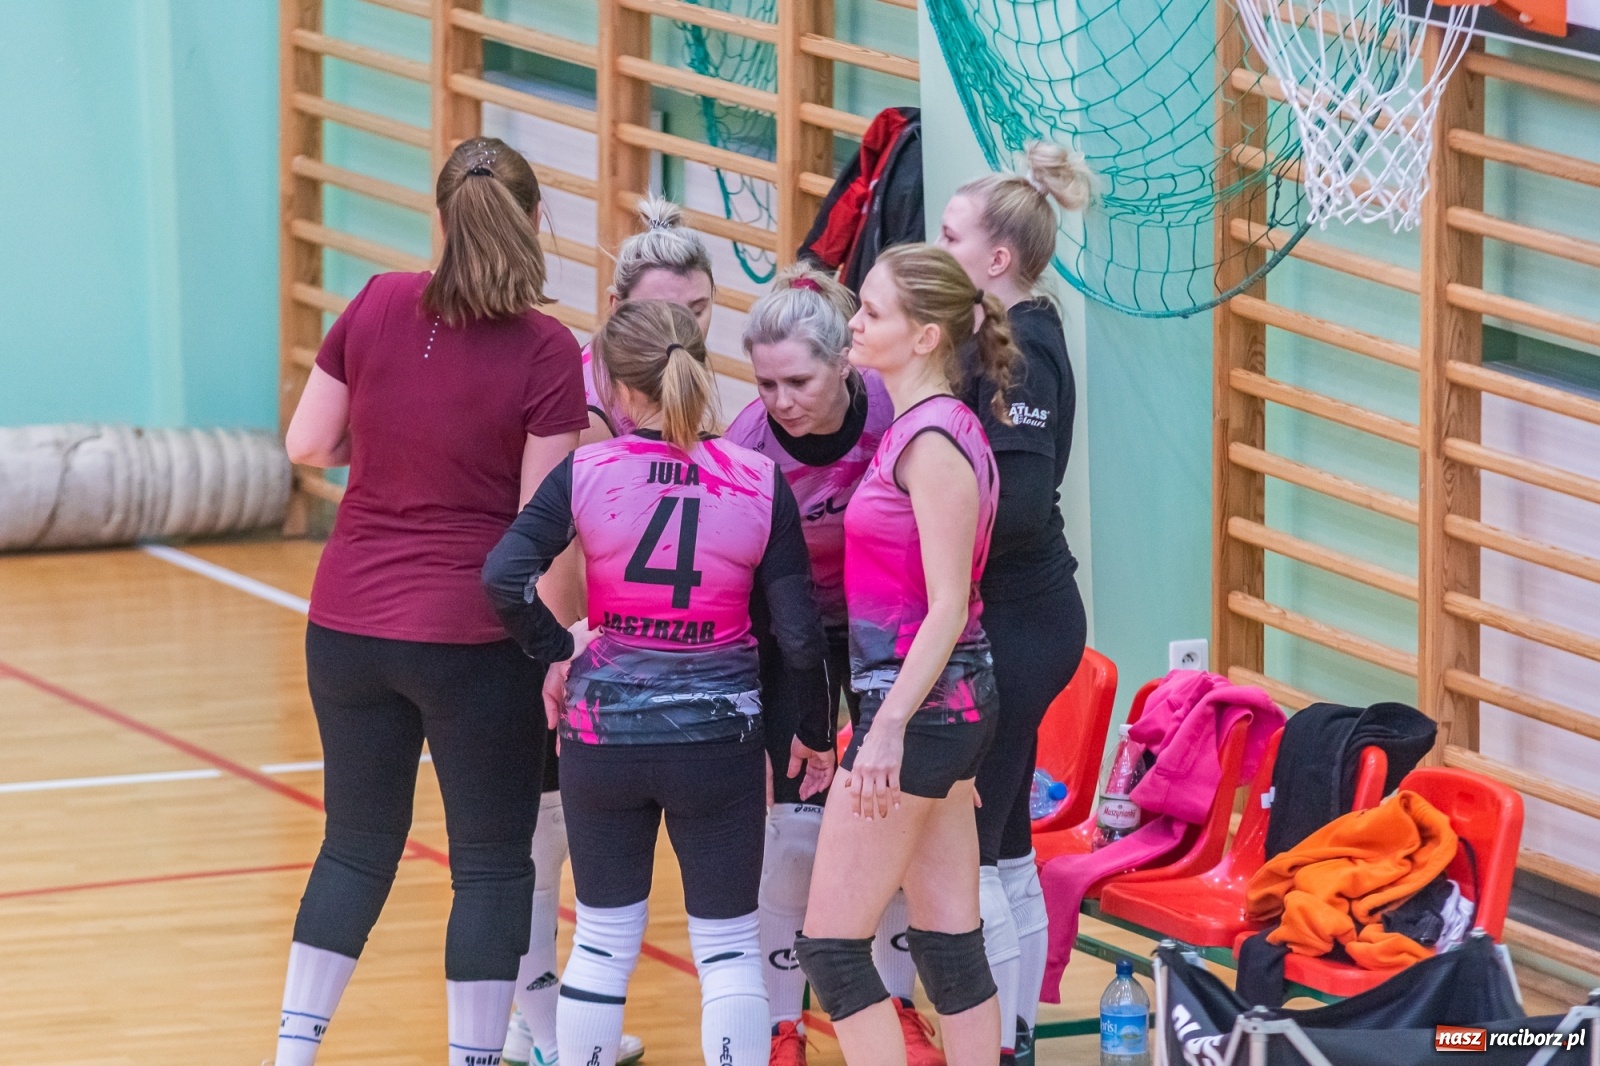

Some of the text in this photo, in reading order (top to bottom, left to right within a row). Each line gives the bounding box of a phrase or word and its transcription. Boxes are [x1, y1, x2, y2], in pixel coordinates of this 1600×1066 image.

[1008, 405, 1047, 421] ATLAS
[646, 461, 699, 486] JULA
[623, 497, 702, 609] 4
